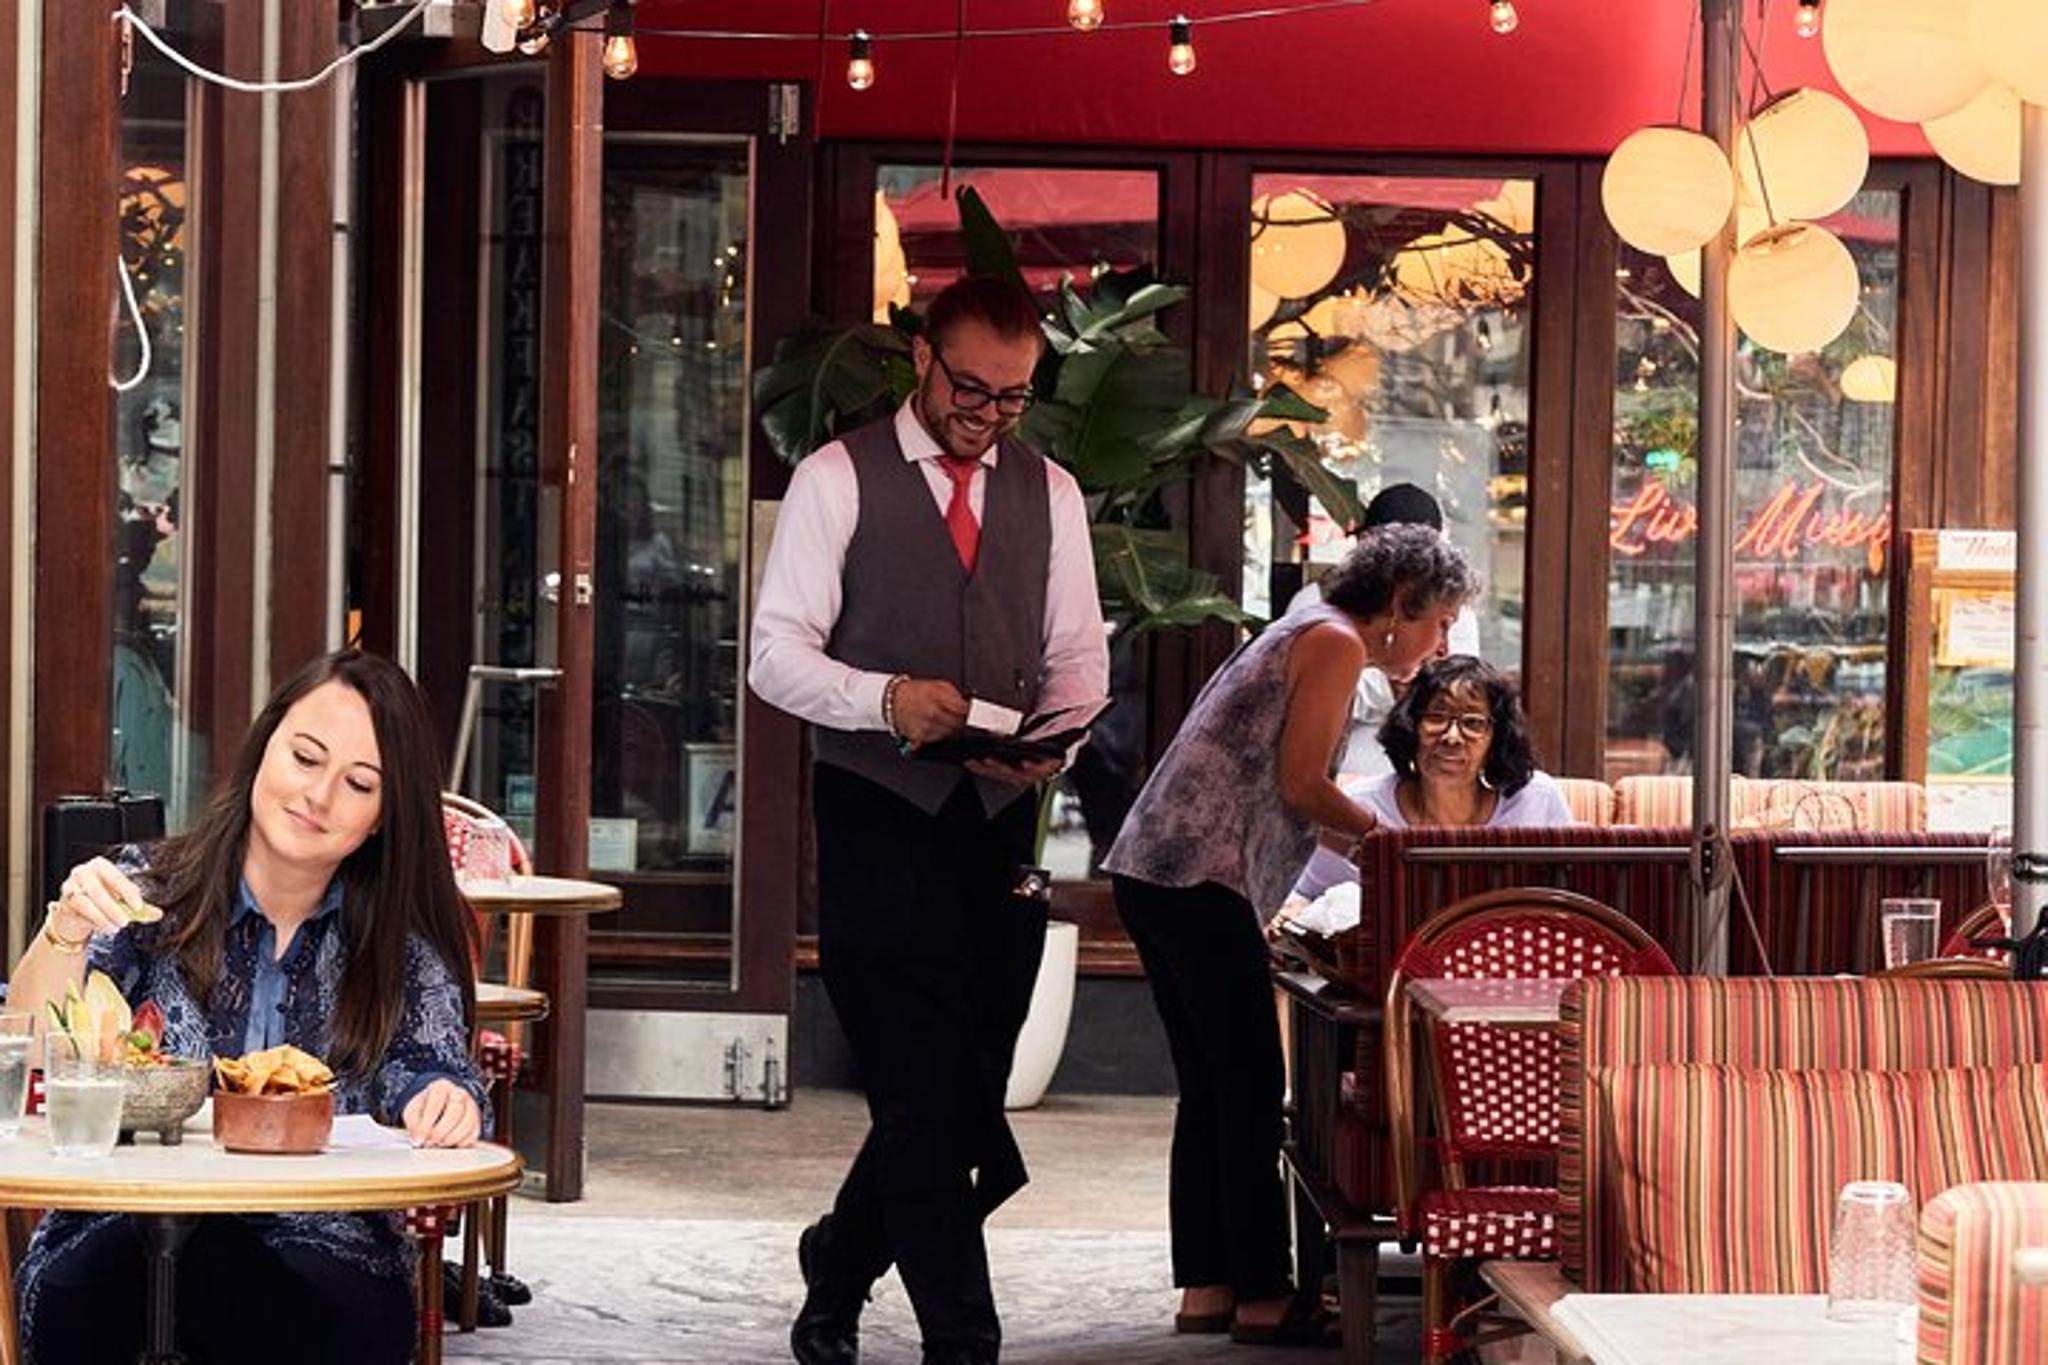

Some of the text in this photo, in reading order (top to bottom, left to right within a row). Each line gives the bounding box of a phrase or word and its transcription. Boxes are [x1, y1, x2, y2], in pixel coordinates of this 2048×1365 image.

[1610, 479, 1892, 558] Liv Musi
[704, 769, 736, 829] A
